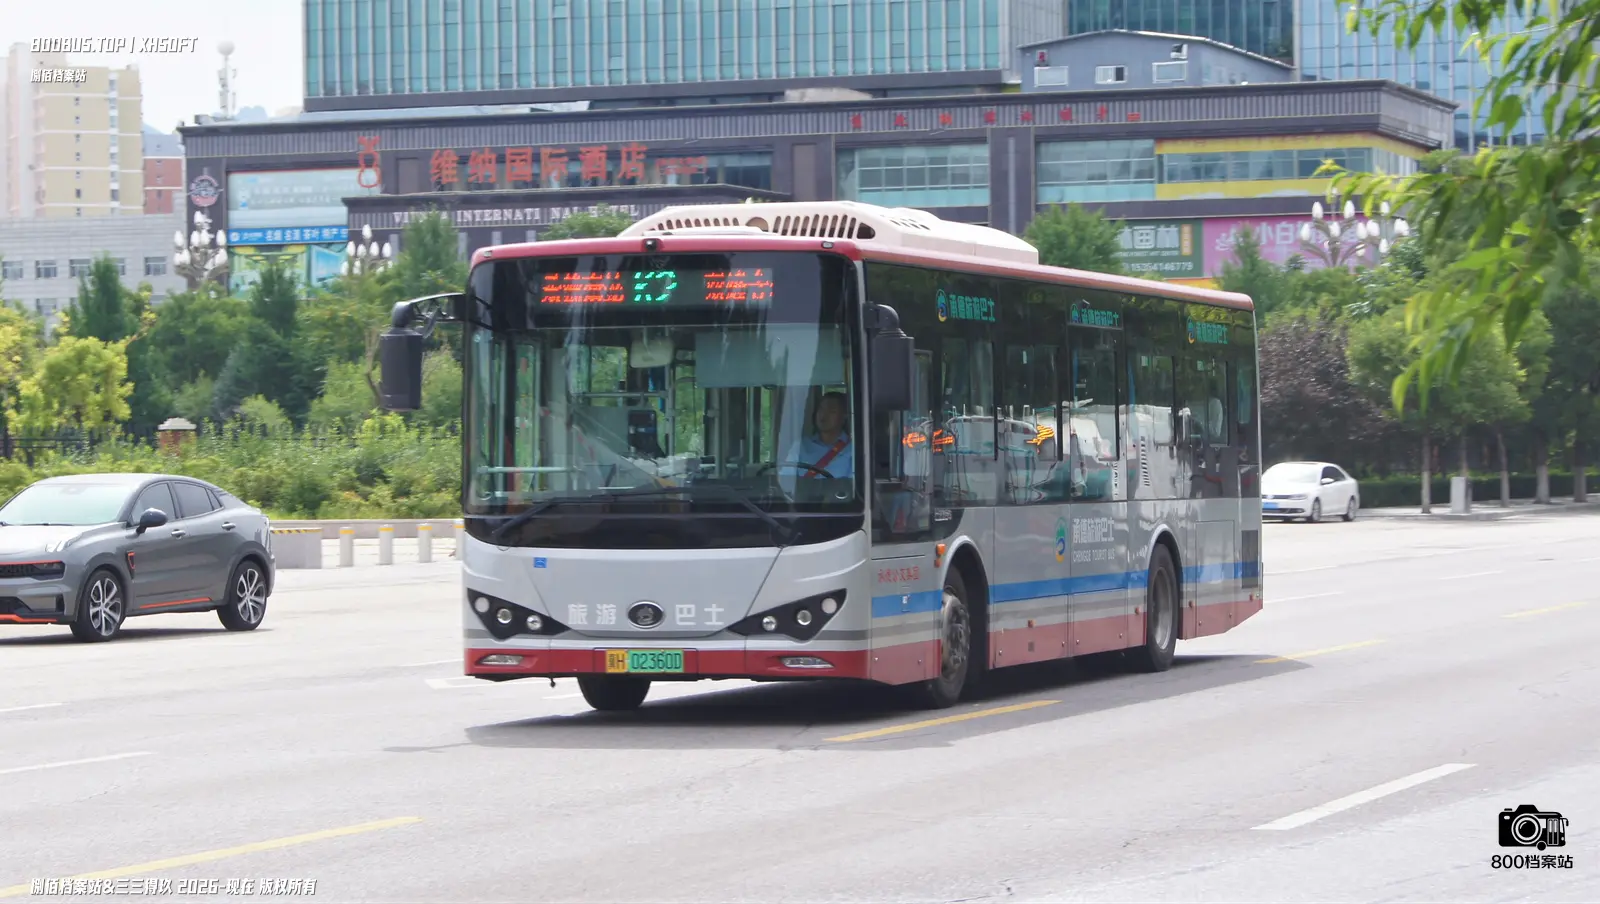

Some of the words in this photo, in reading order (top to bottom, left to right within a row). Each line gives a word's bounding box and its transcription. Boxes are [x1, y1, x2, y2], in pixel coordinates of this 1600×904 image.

[429, 141, 648, 185] 维纳国际酒店
[568, 604, 617, 625] 旅游
[676, 604, 725, 625] 巴士
